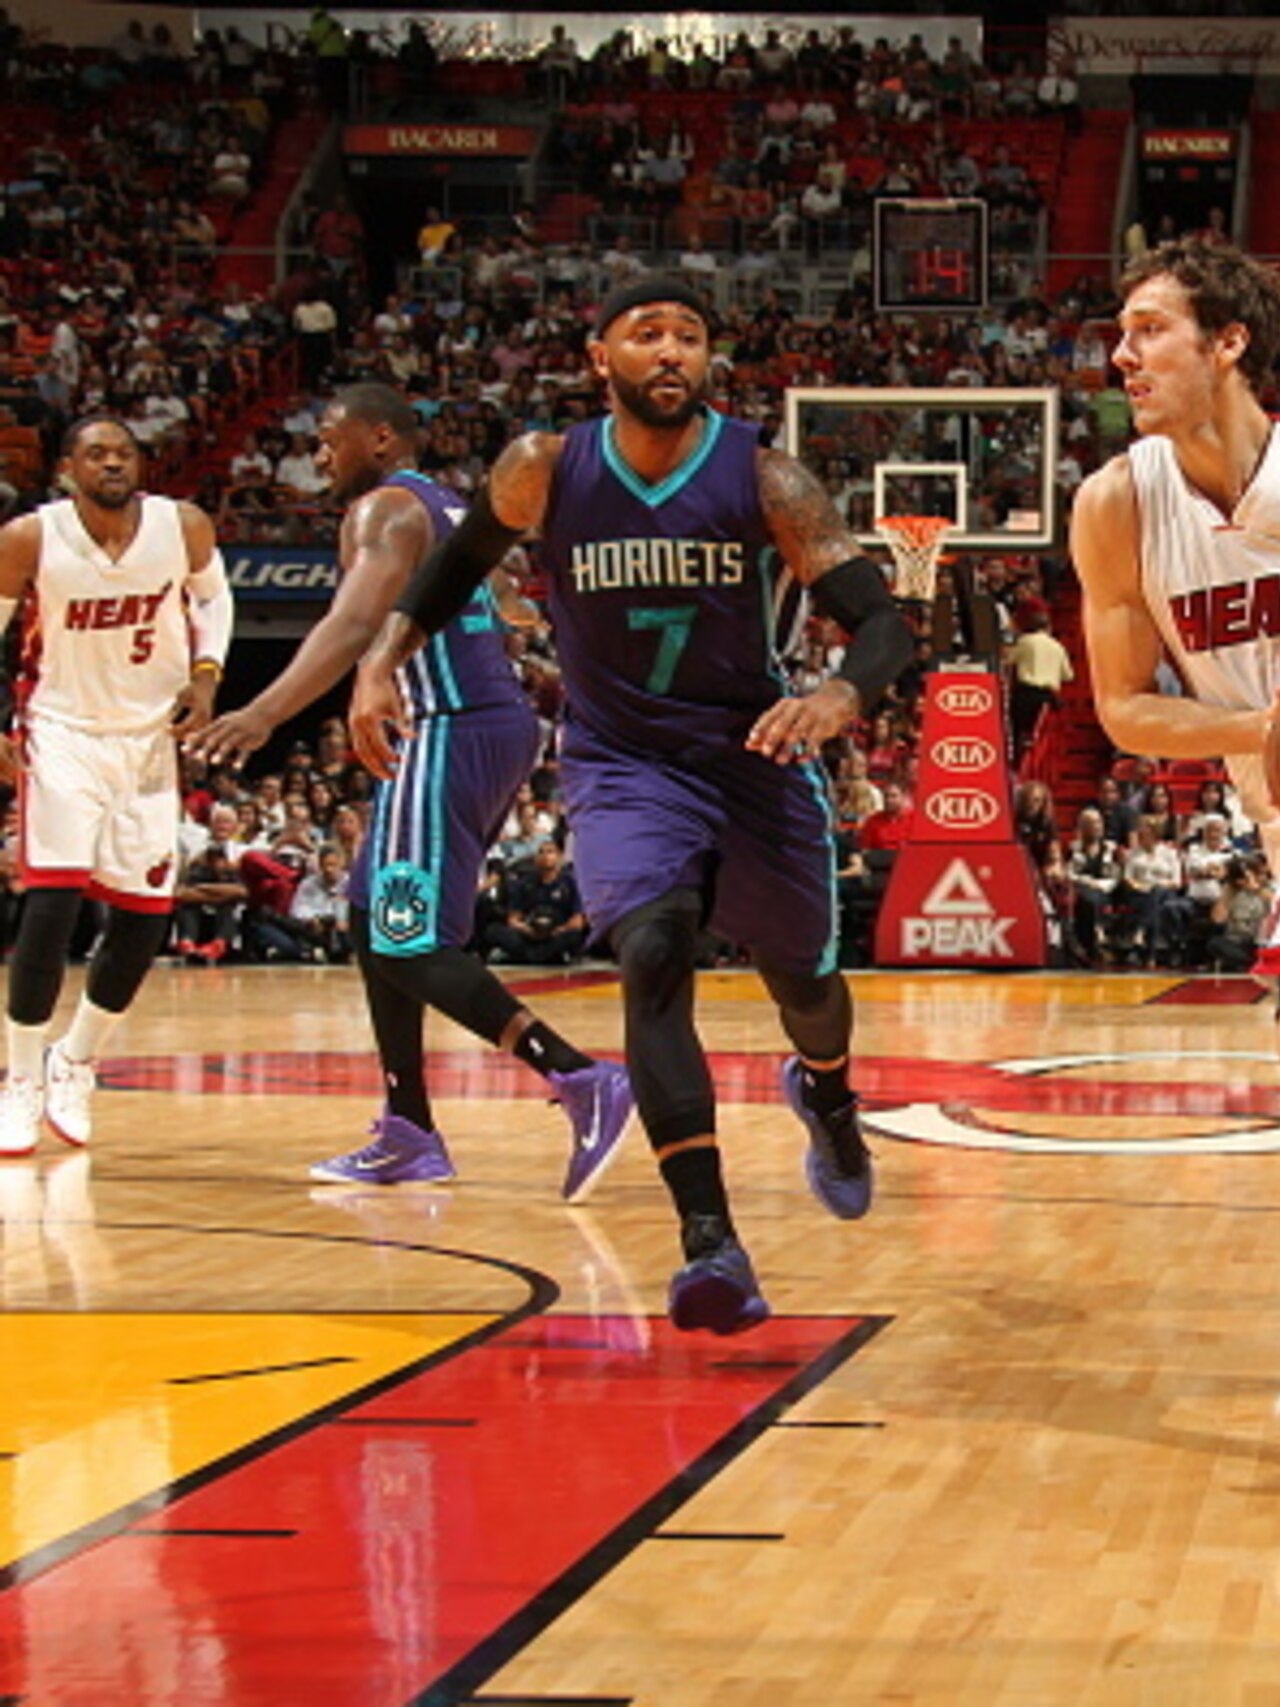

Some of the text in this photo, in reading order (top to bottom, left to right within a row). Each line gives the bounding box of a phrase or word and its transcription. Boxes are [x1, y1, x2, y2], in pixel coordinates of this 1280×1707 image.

[387, 127, 498, 150] BACARDI
[230, 557, 338, 588] LIGH
[572, 538, 743, 592] HORNETS
[65, 581, 173, 630] HEAT
[129, 629, 156, 665] 5
[627, 604, 699, 695] 7
[941, 691, 988, 709] KIA
[941, 744, 987, 765] KIA
[940, 796, 987, 819] KIA
[901, 917, 1017, 958] PEAK
